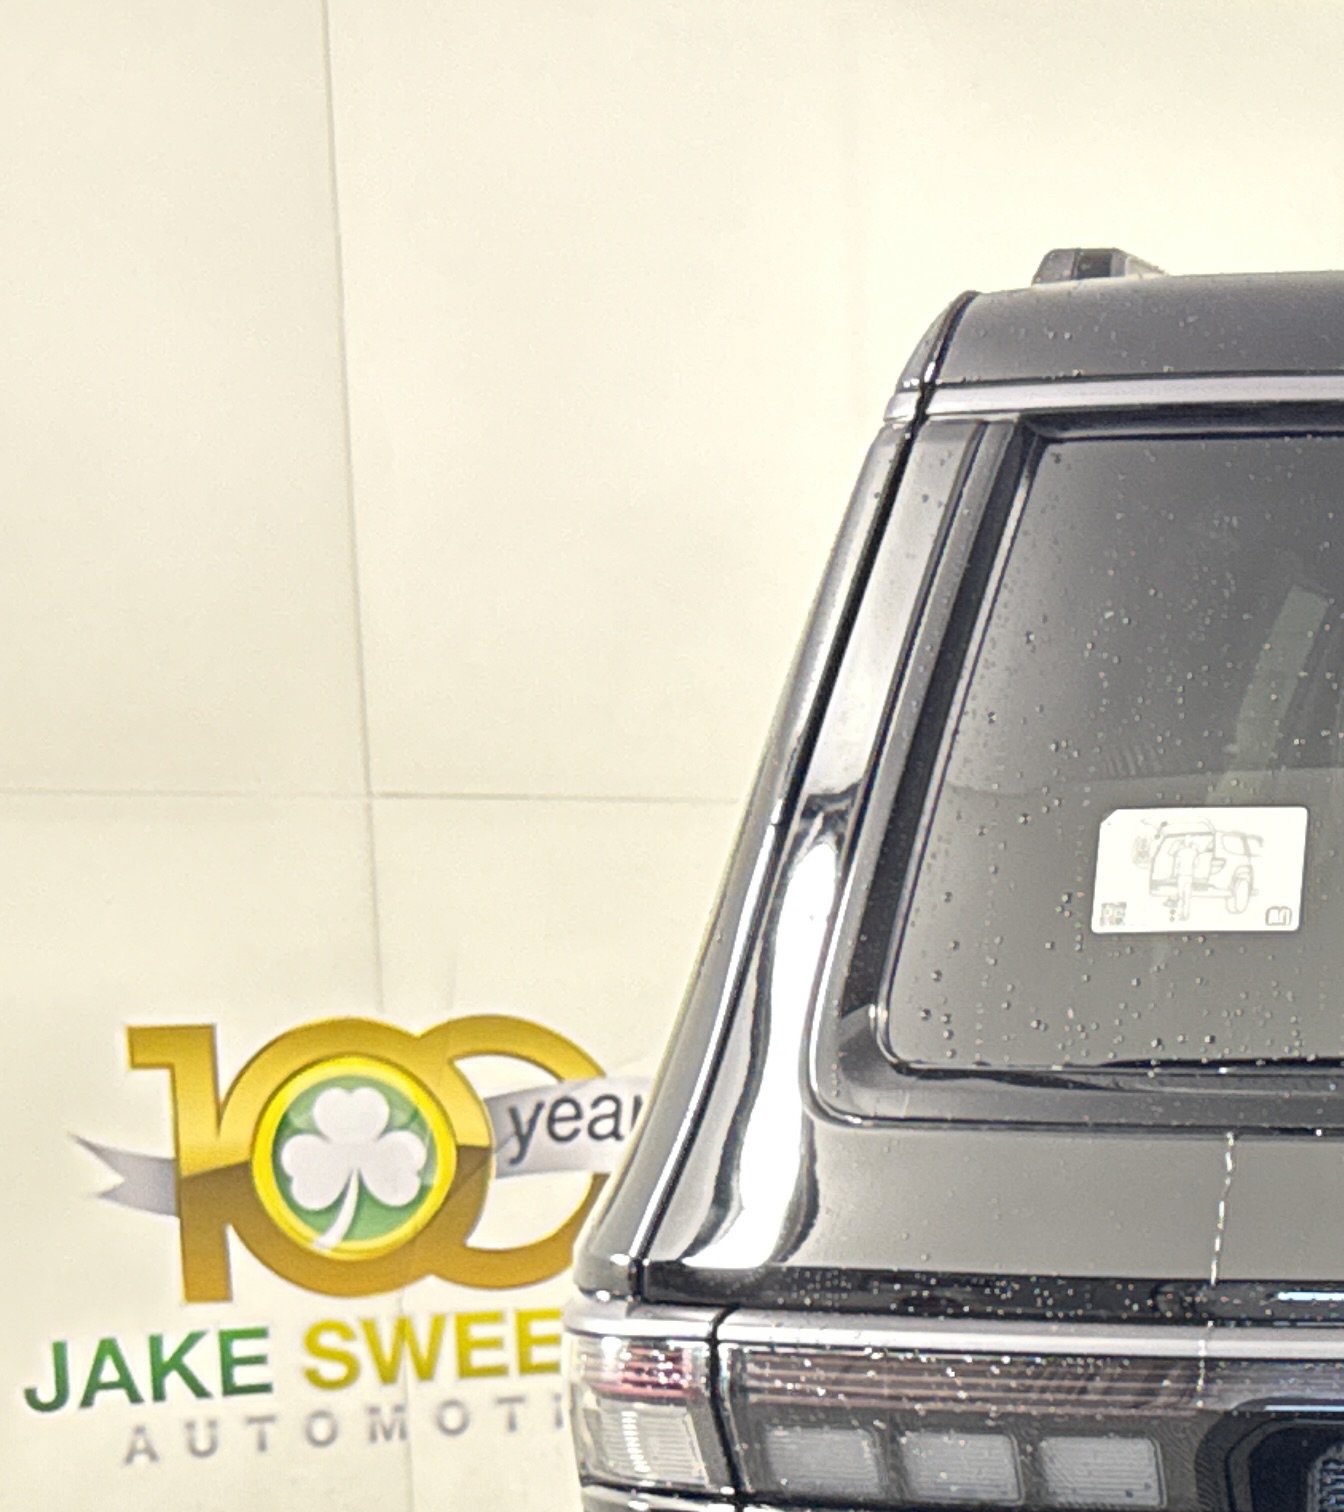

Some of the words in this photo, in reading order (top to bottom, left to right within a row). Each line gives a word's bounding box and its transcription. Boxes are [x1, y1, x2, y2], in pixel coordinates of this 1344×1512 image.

[507, 1092, 642, 1166] yea
[23, 1326, 274, 1414] JAKE
[302, 1308, 563, 1392] SWEE
[124, 1394, 564, 1466] AUTOMOTI
